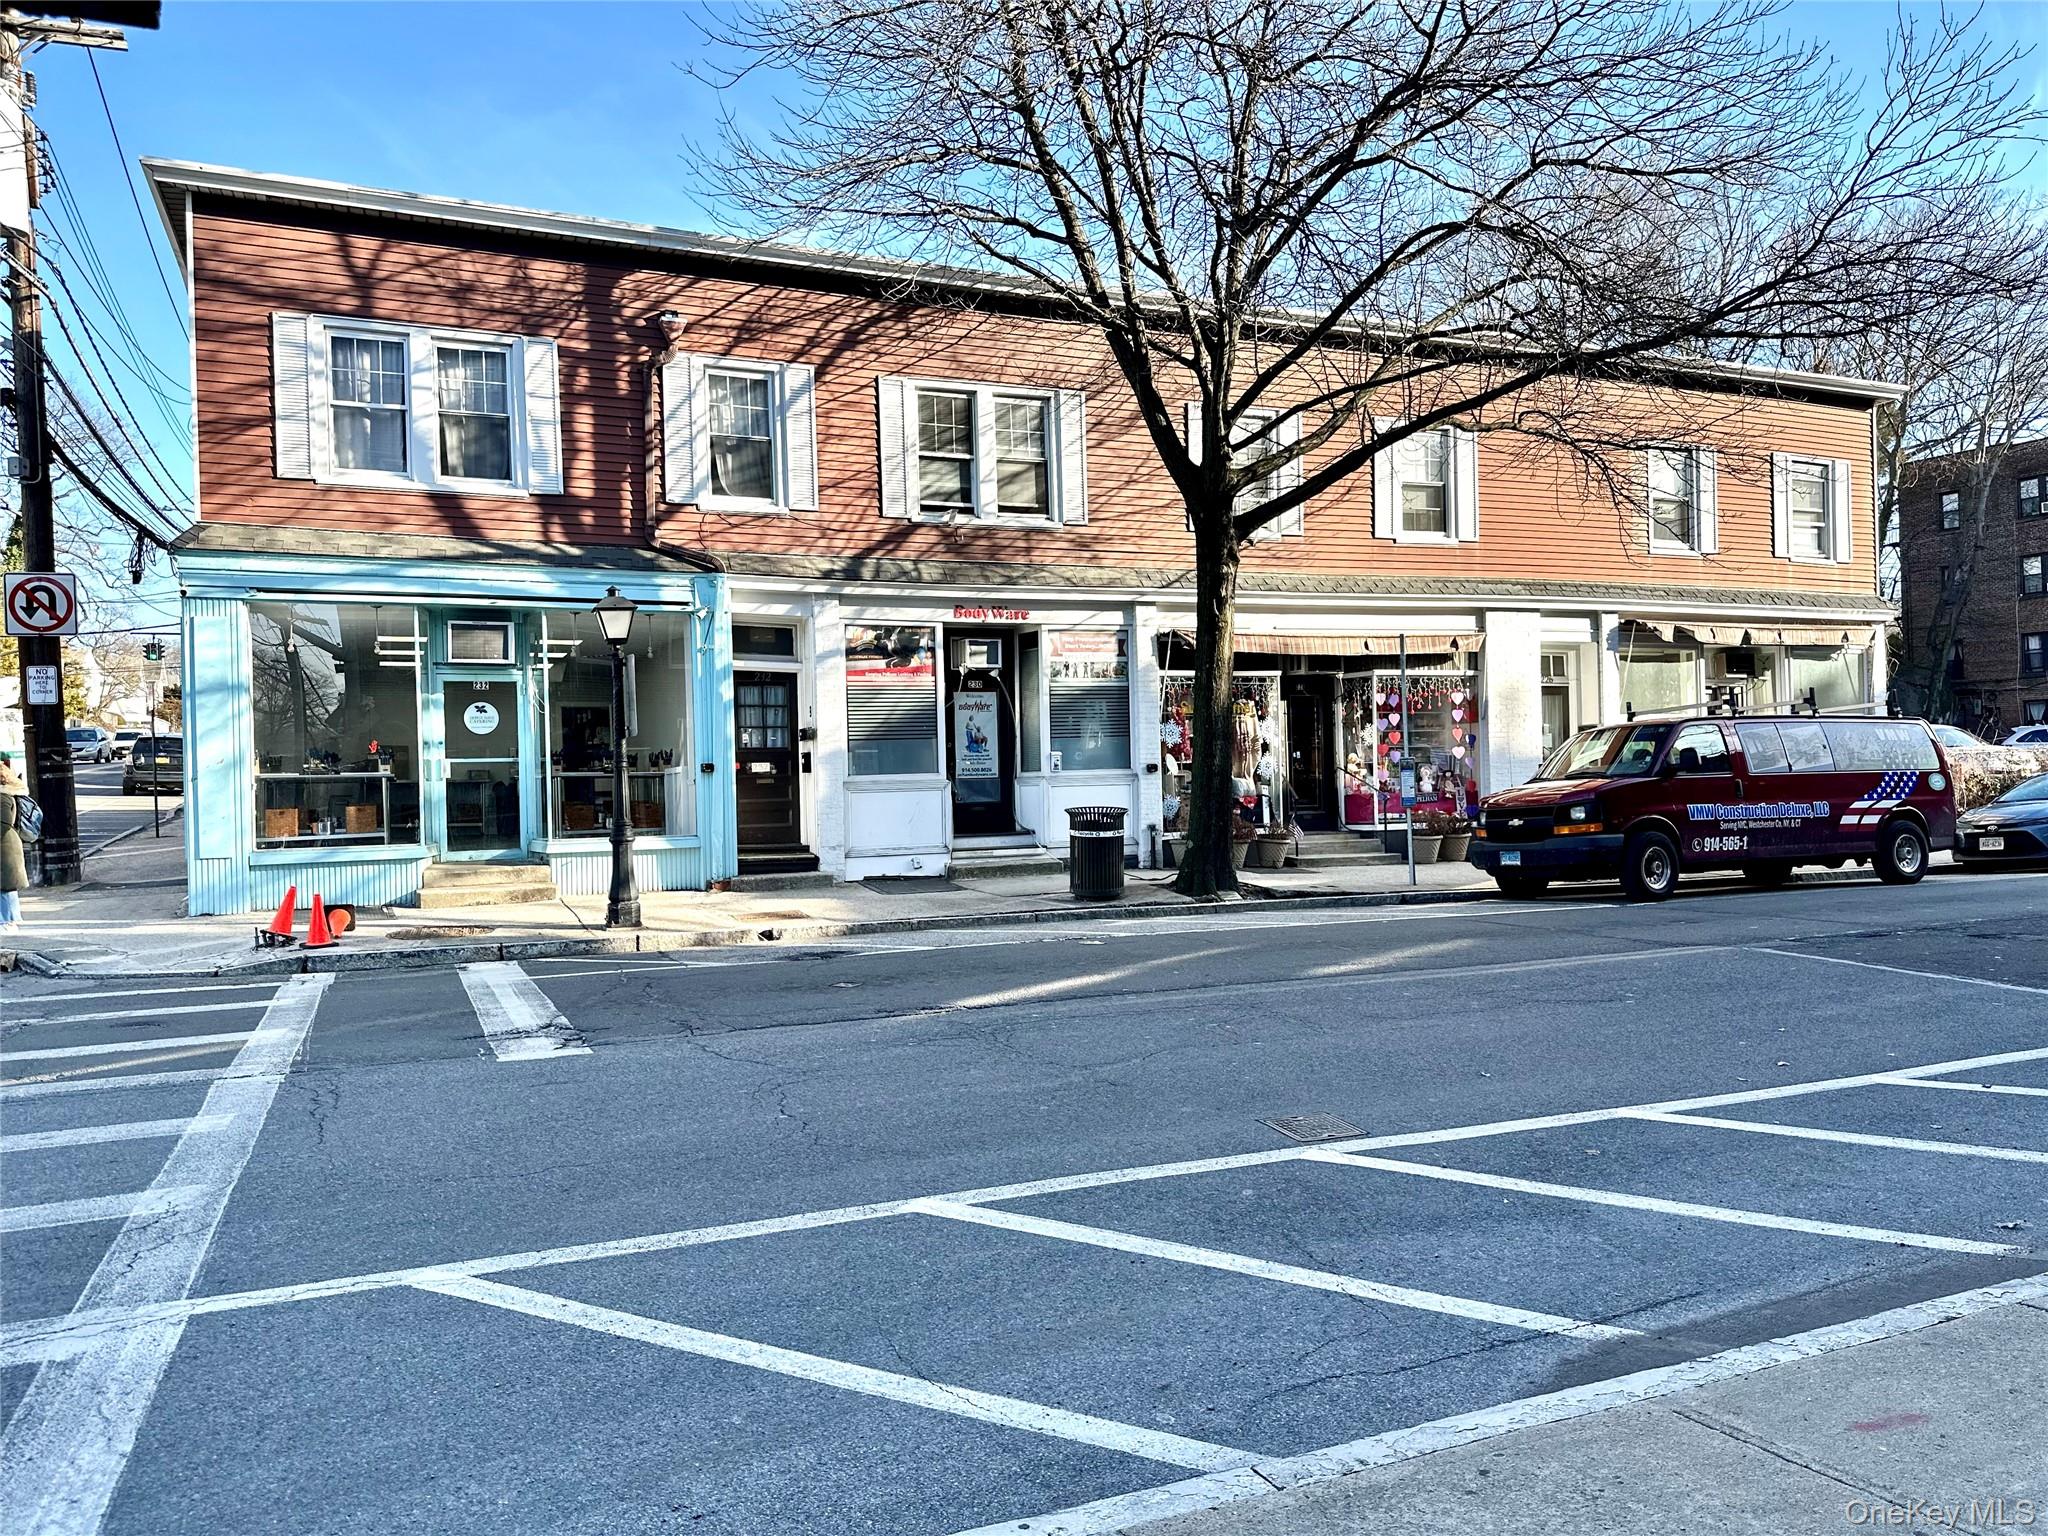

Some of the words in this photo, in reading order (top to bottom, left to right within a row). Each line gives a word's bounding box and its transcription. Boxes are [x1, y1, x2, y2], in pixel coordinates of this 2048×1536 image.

[753, 672, 772, 682] 232
[473, 681, 489, 690] 232
[968, 680, 983, 689] 230
[1416, 795, 1438, 803] PELHAM
[1687, 803, 1715, 820] VMW
[1715, 802, 1779, 820] Construction
[1778, 801, 1815, 819] Deluxe,
[1813, 801, 1830, 817] LLC
[1720, 821, 1737, 831] Serving
[1749, 819, 1775, 829] Westchester
[1704, 836, 1748, 851] 914-565-1
